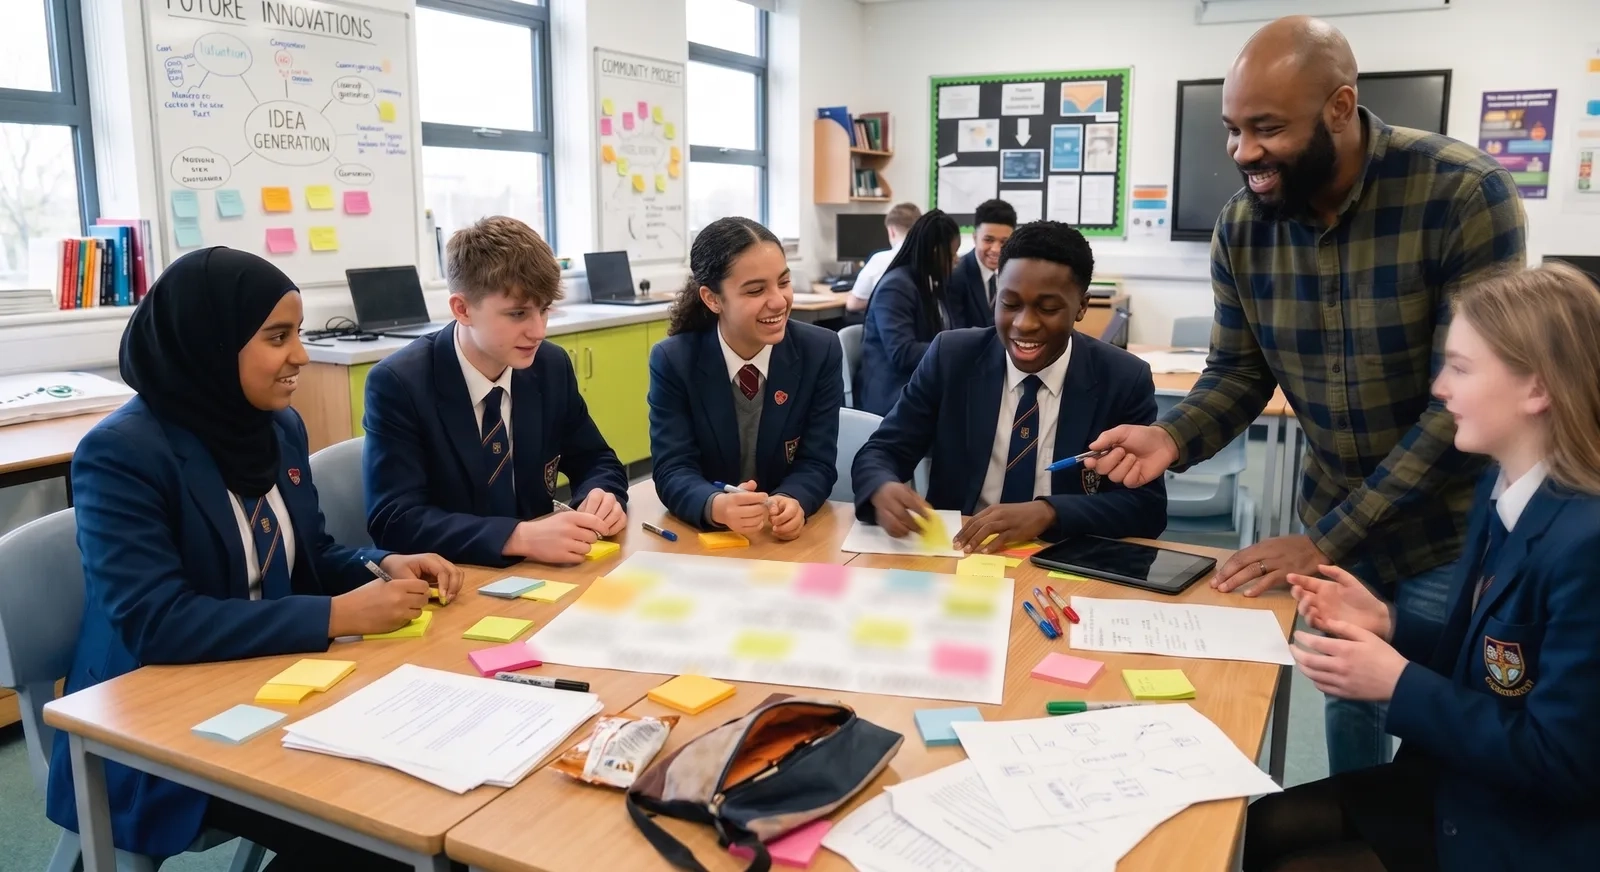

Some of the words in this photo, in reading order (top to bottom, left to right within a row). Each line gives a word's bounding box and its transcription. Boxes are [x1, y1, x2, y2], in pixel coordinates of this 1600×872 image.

[262, 0, 373, 39] INNOVATIONS
[602, 59, 649, 79] COMMUNITY
[269, 109, 306, 130] IDEA
[254, 133, 330, 152] GENERATION
